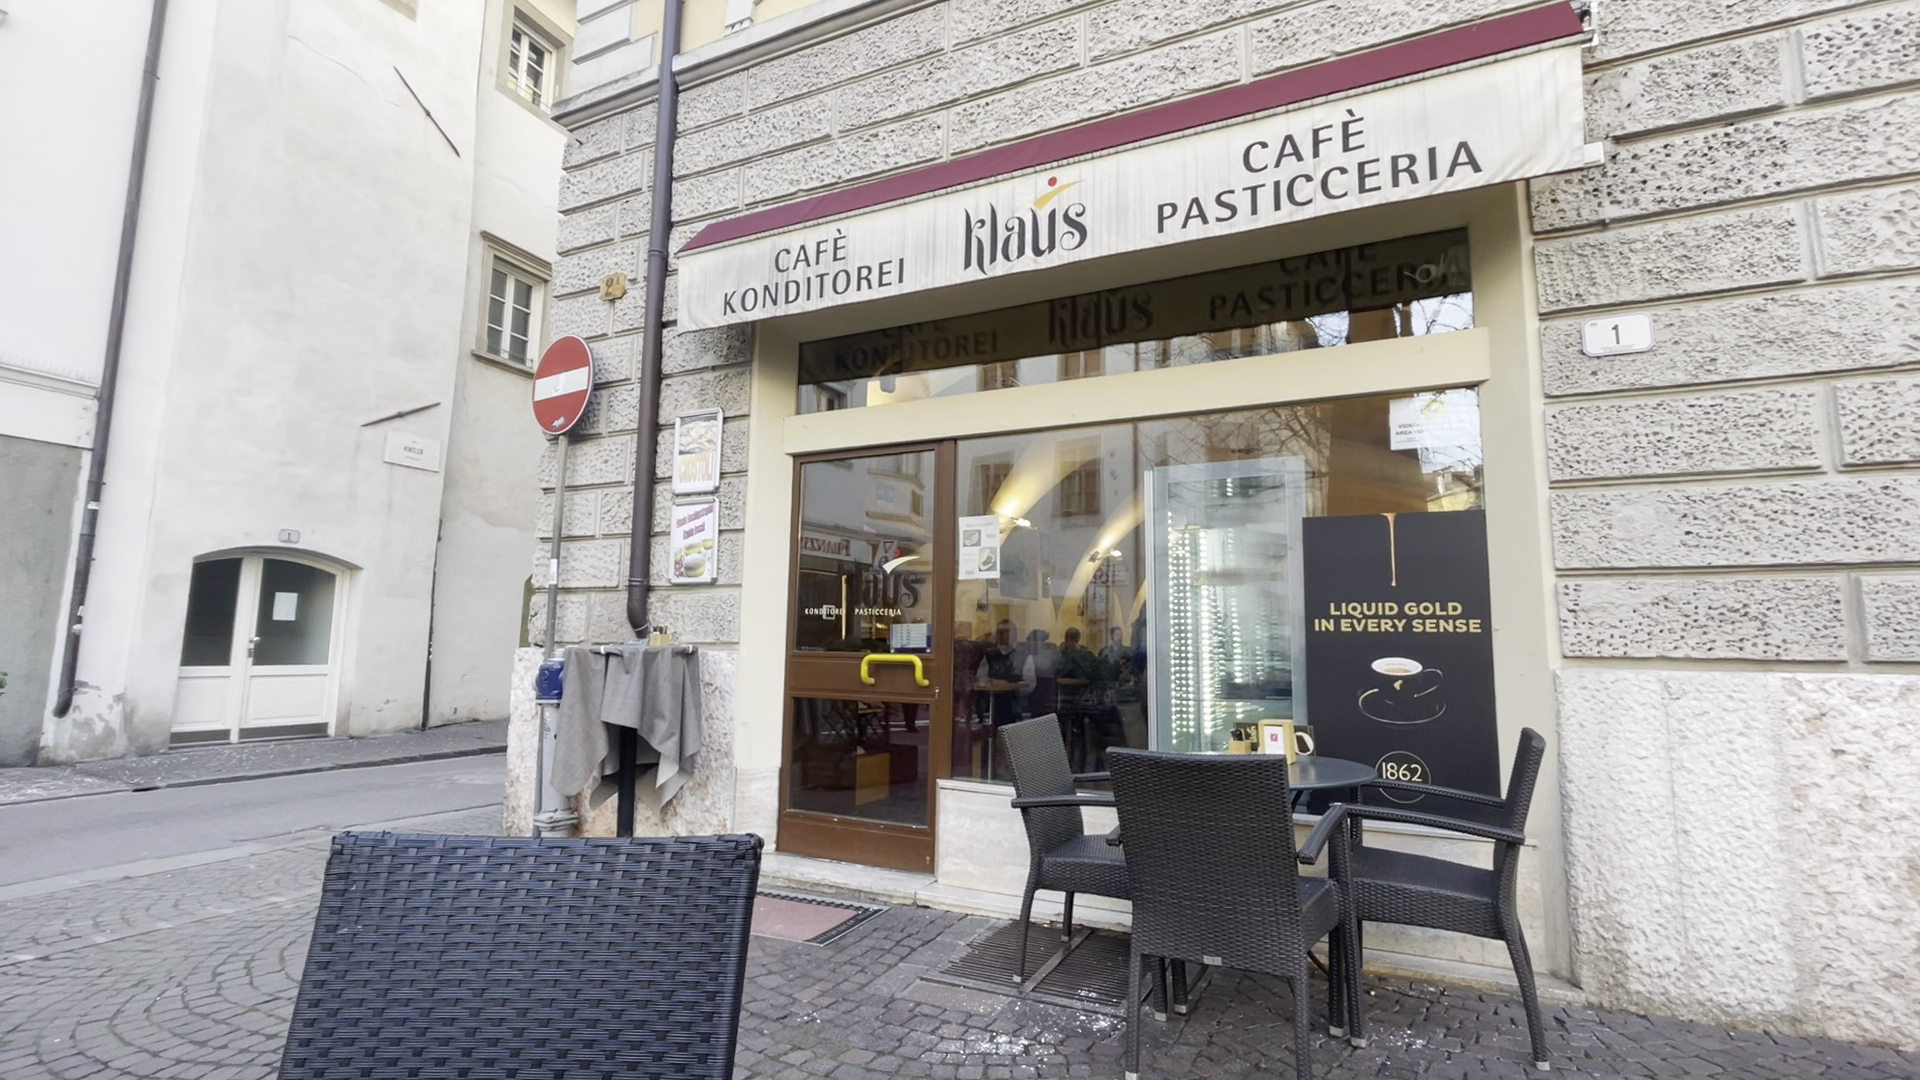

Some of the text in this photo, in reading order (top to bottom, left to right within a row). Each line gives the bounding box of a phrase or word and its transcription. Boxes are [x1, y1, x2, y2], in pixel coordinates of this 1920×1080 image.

[1242, 108, 1366, 174] CAFÈ
[1156, 140, 1483, 234] PASTICCERIA
[774, 228, 847, 274] CAFÈ
[963, 201, 1088, 276] klaus
[723, 257, 905, 316] KONDITOREI
[1611, 323, 1621, 346] 1
[854, 607, 902, 617] PASTICCERIA
[1314, 618, 1483, 633] IN EVERY SENSE
[1329, 602, 1463, 618] LIQUID GOLD
[1381, 761, 1423, 782] 1862
